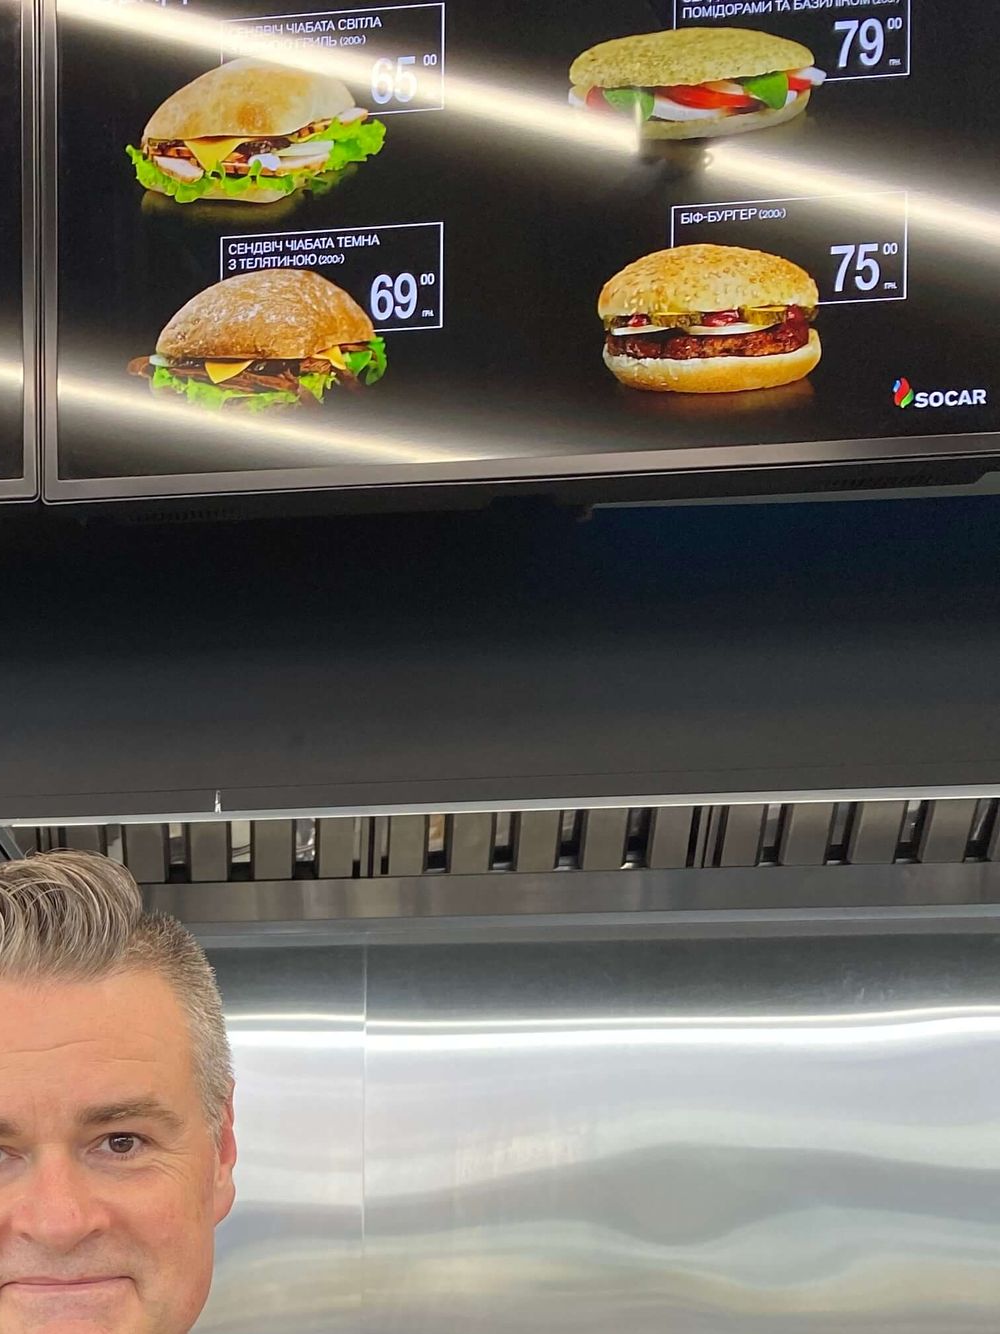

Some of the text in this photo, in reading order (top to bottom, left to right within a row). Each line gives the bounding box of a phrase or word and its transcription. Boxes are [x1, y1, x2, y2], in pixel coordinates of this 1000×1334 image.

[682, 1, 772, 19] ПОМІДОРАМИ
[775, 0, 790, 12] ТА
[286, 20, 335, 33] ЧІАБАТА
[338, 16, 382, 31] СВІТЛА
[887, 17, 902, 30] 00
[834, 18, 885, 68] 79
[423, 54, 437, 66] 00
[371, 56, 418, 105] 65
[680, 208, 757, 225] БІФ-БУРГЕР
[228, 234, 381, 256] СЕНДВІЧ ЧІАБАТА ТЕМНА
[883, 242, 898, 255] 00
[238, 254, 317, 270] ТЕЛЯТИНОЮ
[830, 243, 881, 292] 75
[420, 273, 435, 285] 00
[370, 272, 418, 321] 69
[914, 389, 987, 408] SOCAR
